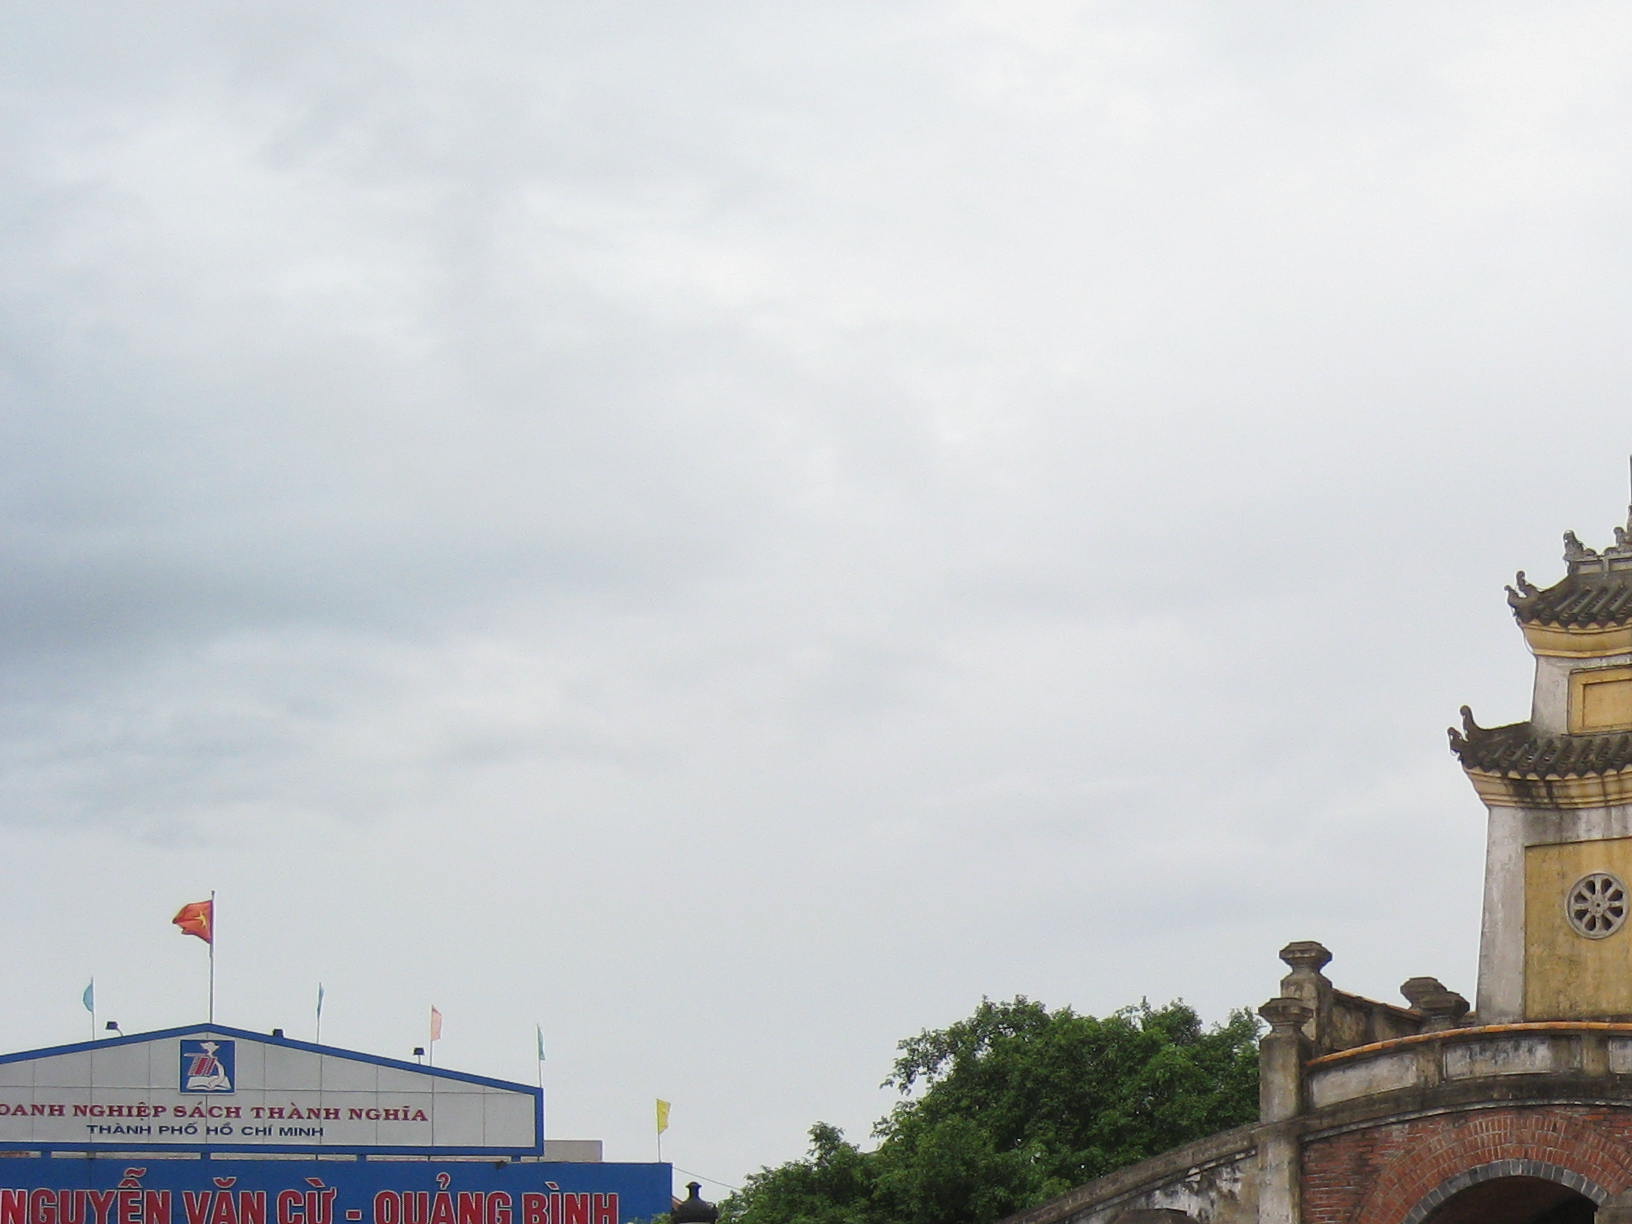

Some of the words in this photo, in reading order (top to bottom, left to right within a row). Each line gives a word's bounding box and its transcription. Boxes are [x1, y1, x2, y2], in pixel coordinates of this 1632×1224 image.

[73, 1101, 167, 1121] NGHIỆP
[173, 1101, 242, 1119] SÁCH
[251, 1102, 341, 1120] THÀNH
[347, 1106, 429, 1122] NGHĨA
[87, 1122, 151, 1135] THÀNH
[159, 1121, 199, 1136] PHỐ
[206, 1121, 233, 1136] HỒ
[241, 1125, 273, 1137] CHÍ
[279, 1127, 324, 1137] MINH
[346, 1209, 361, 1221] -
